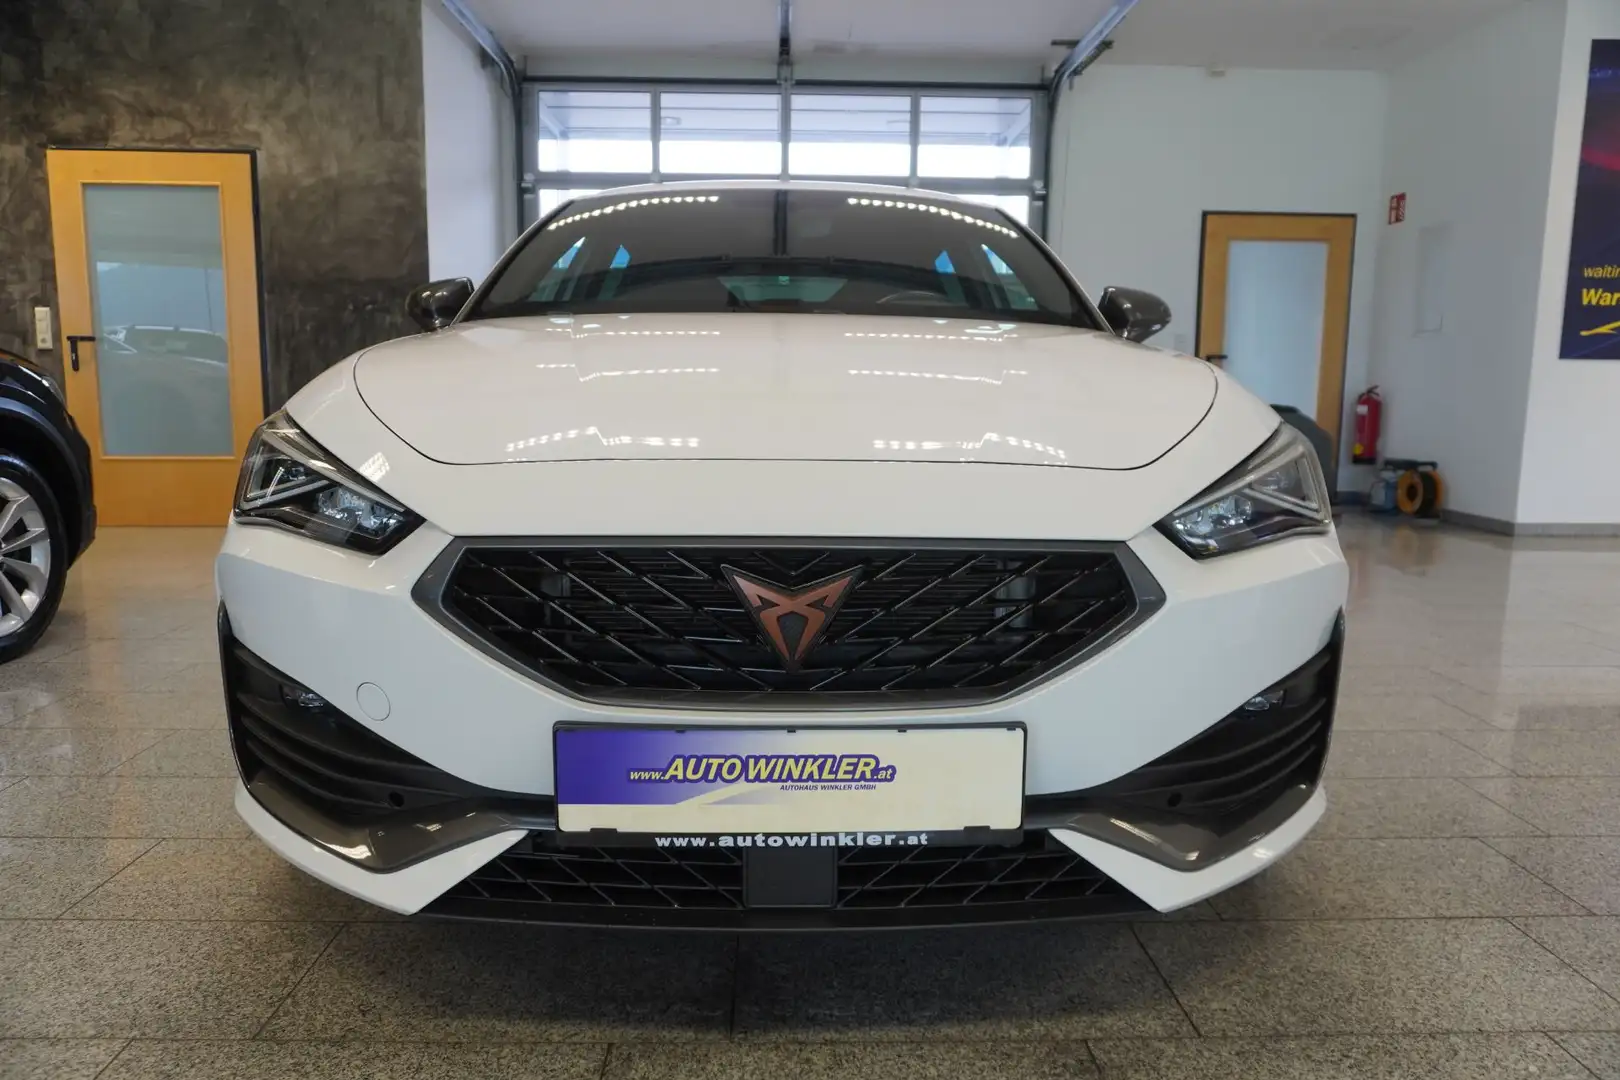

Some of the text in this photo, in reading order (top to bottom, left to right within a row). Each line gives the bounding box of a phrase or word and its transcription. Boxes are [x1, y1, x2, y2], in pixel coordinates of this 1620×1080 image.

[780, 783, 877, 792] AUTOHAUS WINKLER GMBH
[654, 832, 929, 848] www.autowinkler.at
